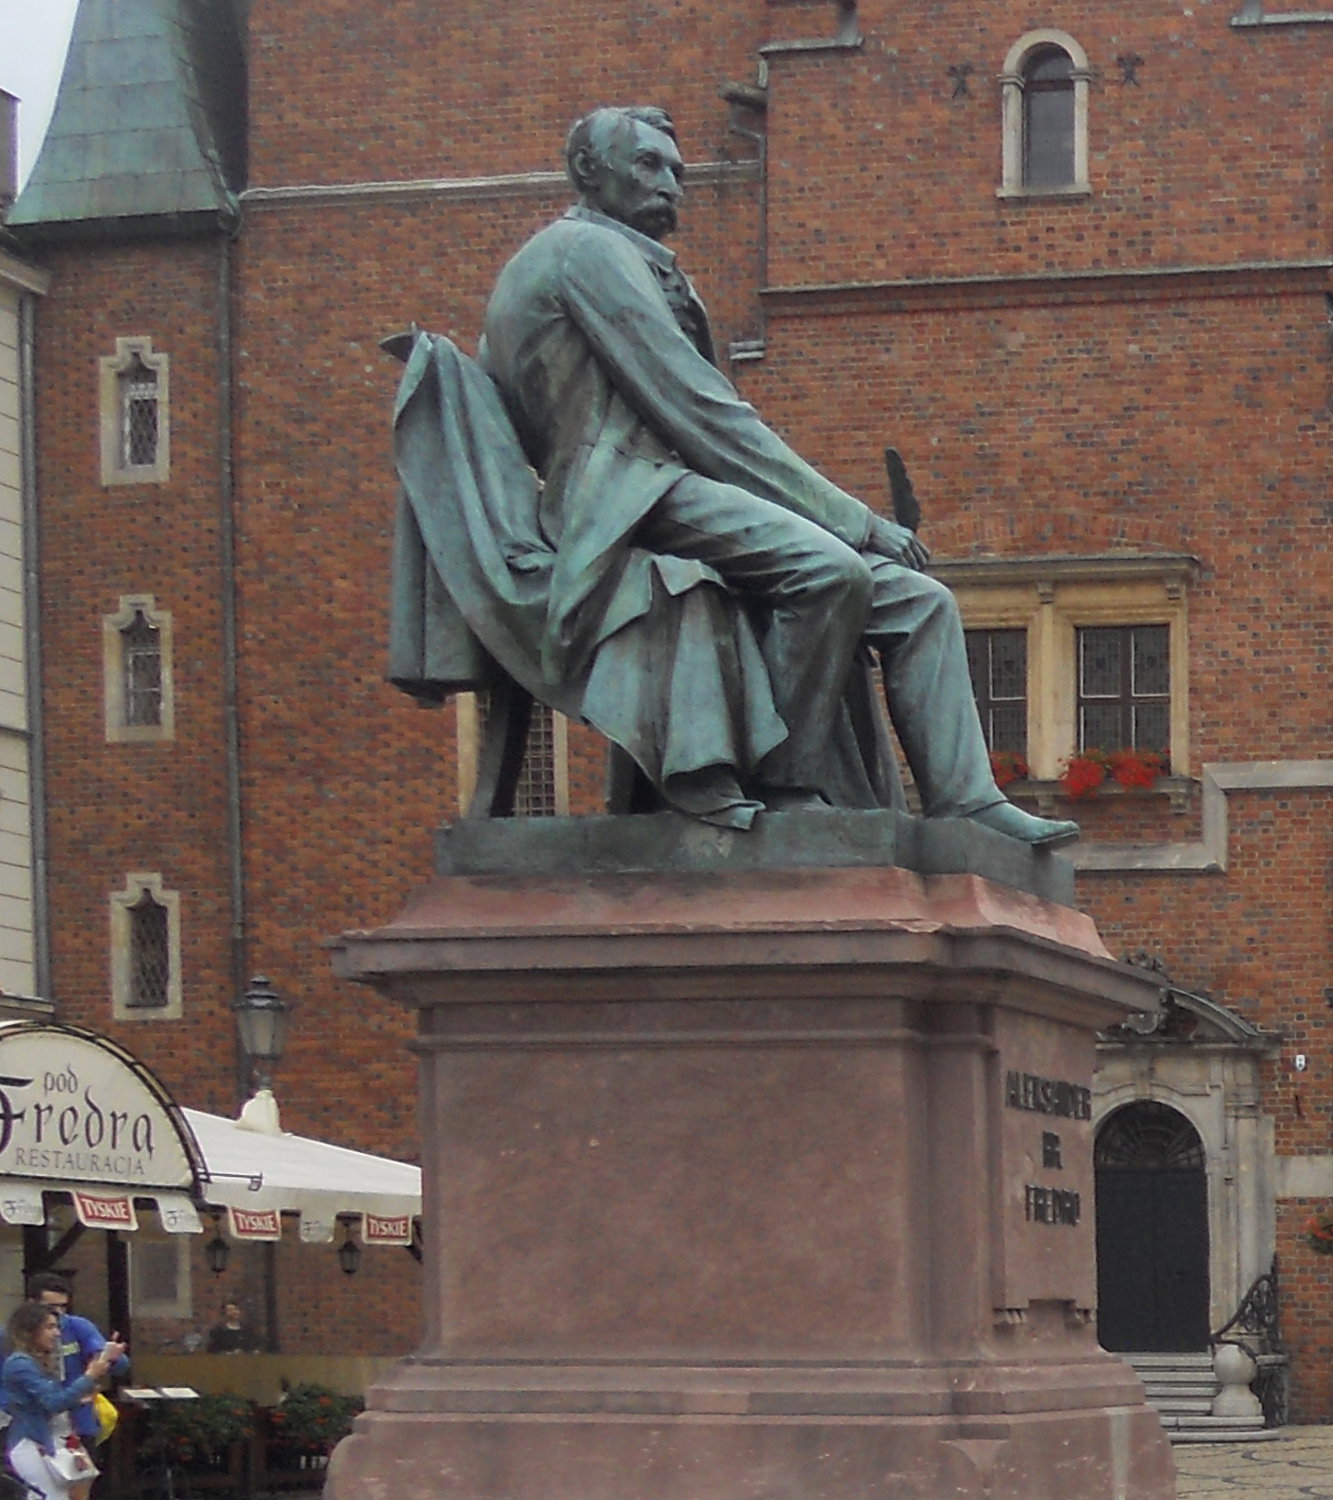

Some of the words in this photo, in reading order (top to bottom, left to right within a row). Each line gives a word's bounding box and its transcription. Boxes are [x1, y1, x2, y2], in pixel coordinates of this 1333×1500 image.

[44, 1063, 78, 1098] pod
[16, 1147, 144, 1176] RESTAURACJA
[82, 1198, 129, 1219] TYSKIE
[236, 1212, 277, 1232] TYSKIE
[369, 1218, 407, 1237] TYSKIE
